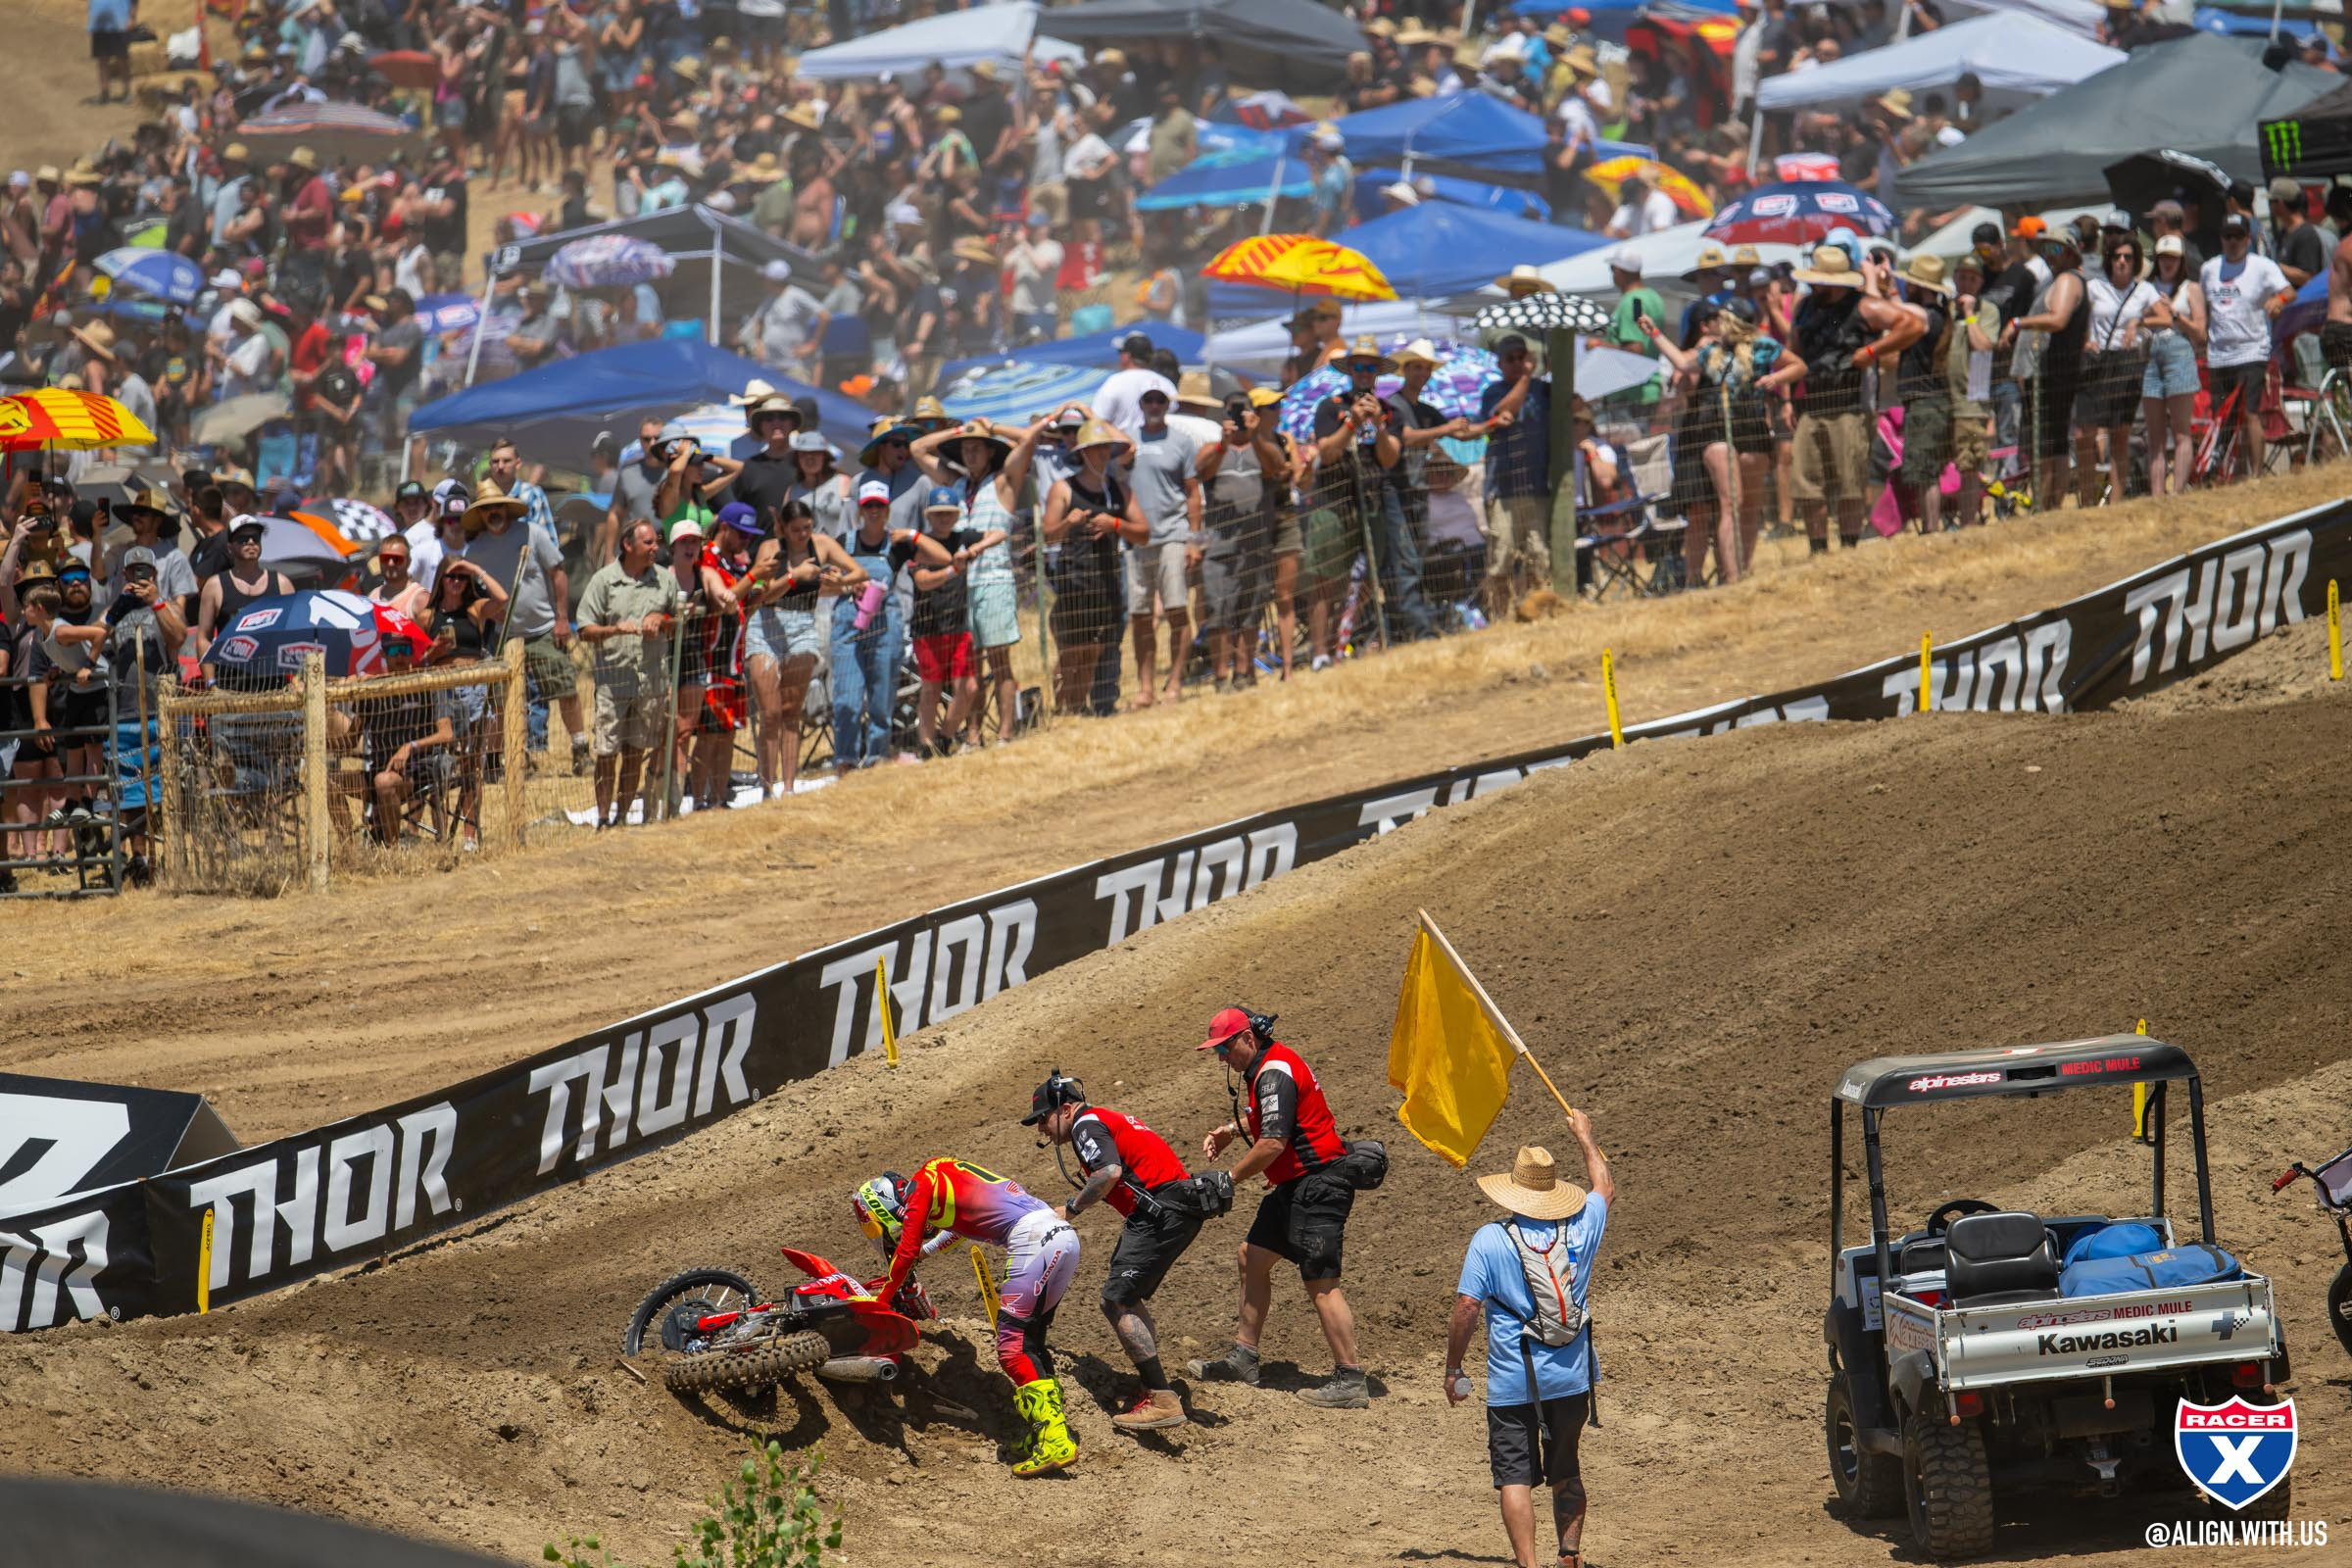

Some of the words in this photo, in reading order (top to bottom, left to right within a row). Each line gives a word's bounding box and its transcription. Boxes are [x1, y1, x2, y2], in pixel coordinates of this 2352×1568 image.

[2125, 527, 2313, 685] THOR
[820, 897, 1038, 1069] THOR
[527, 992, 757, 1176] THOR
[1909, 1071, 2001, 1094] alpinestars
[2061, 1059, 2103, 1076] MEDIC
[2105, 1056, 2141, 1072] MULE
[190, 1101, 457, 1292] THOR
[1040, 1250, 1062, 1286] HONDA
[2017, 1308, 2111, 1331] alpinestars
[2113, 1303, 2154, 1320] MEDIC
[2157, 1300, 2193, 1316] MULE
[2037, 1318, 2178, 1356] Kawasaki
